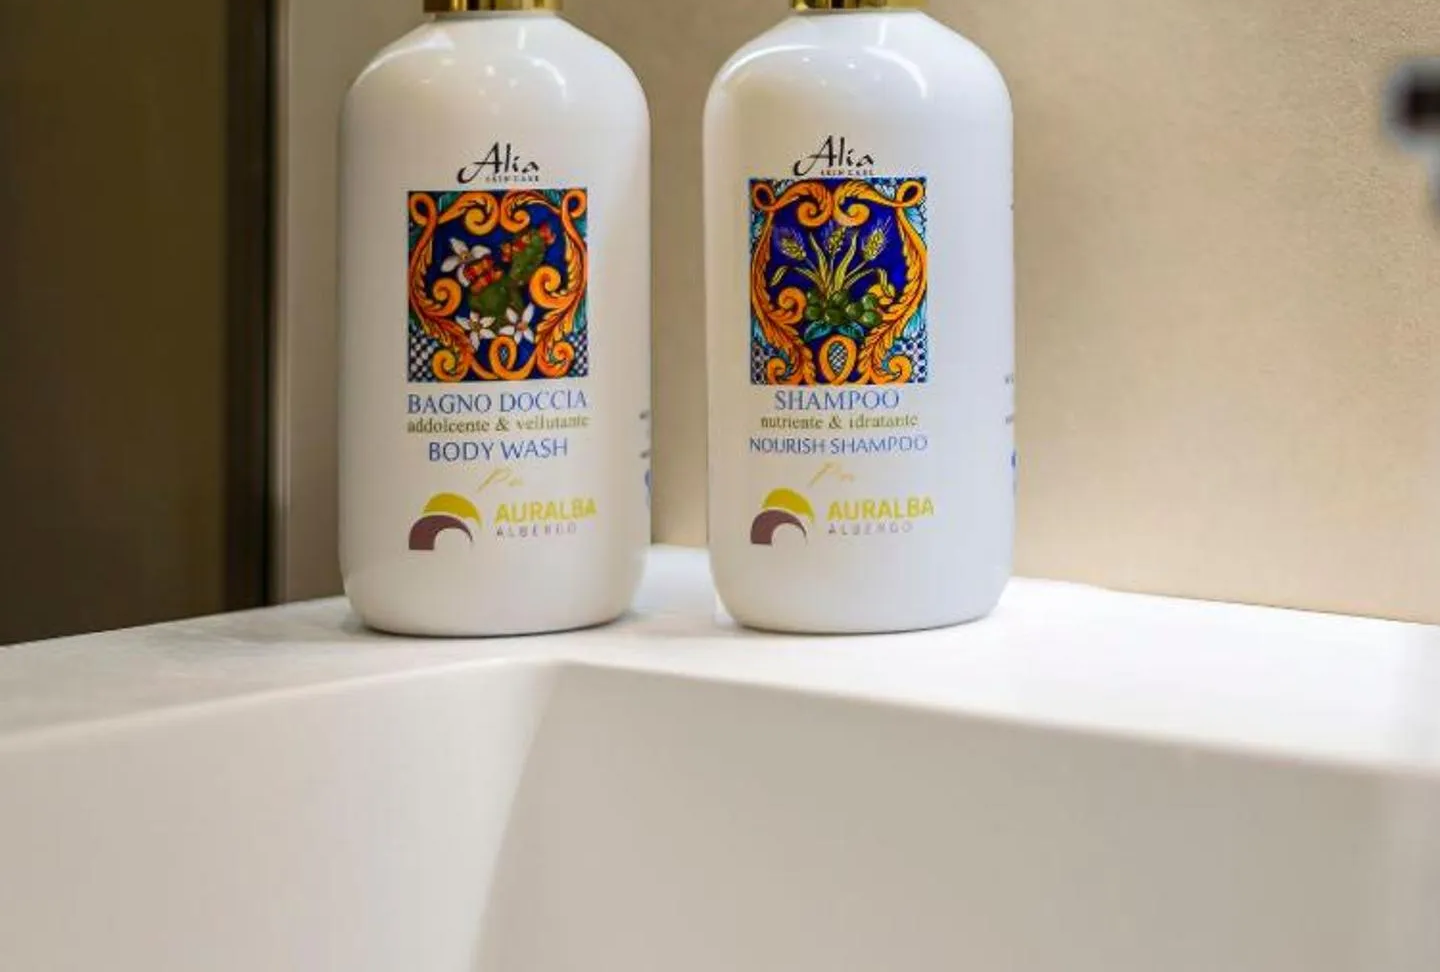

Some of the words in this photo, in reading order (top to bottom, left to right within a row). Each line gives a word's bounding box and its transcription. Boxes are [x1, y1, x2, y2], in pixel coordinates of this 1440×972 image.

[457, 141, 540, 184] Alia
[793, 135, 874, 176] Alia
[407, 394, 492, 414] BAGNO
[500, 389, 588, 413] DOCCIA
[774, 389, 900, 410] SHAMPOO
[407, 416, 491, 434] addolcente
[495, 417, 509, 432] &
[761, 414, 825, 429] nutriente
[828, 414, 842, 429] &
[849, 412, 919, 428] idratante
[428, 441, 495, 462] BODY
[500, 438, 568, 460] WASH
[749, 436, 826, 455] NOURISH
[830, 434, 929, 455] SHAMPOO
[496, 499, 597, 523] AURALBA
[826, 497, 935, 521] AURALBA
